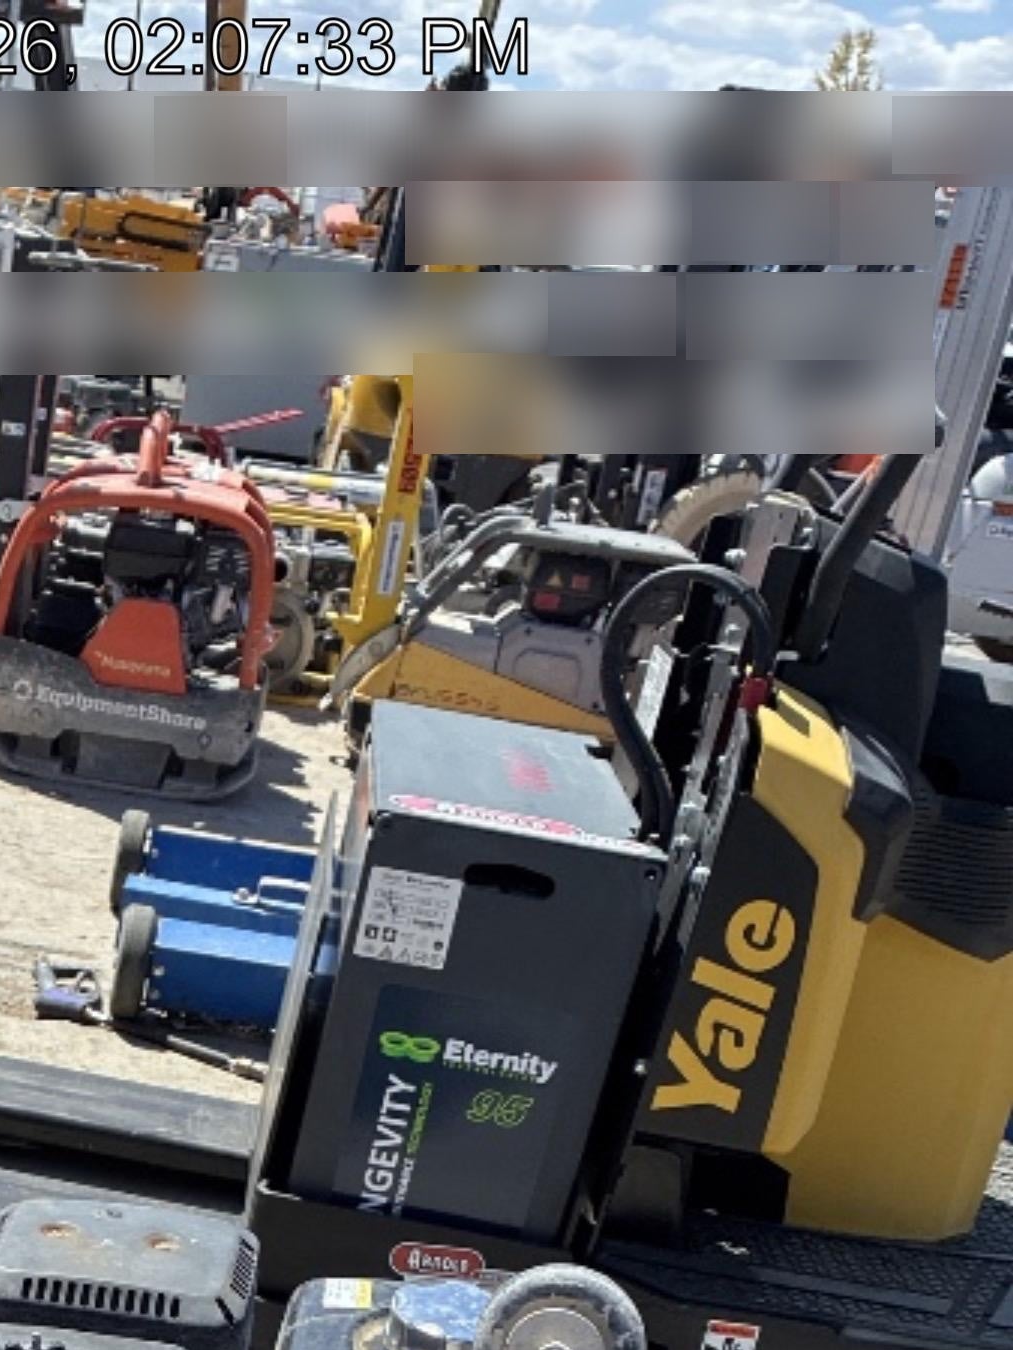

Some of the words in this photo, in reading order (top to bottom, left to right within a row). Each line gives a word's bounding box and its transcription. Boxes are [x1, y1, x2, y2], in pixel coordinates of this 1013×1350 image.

[38, 683, 207, 731] EquipmentShare
[650, 898, 796, 1114] Yale
[443, 1038, 559, 1084] Eternity
